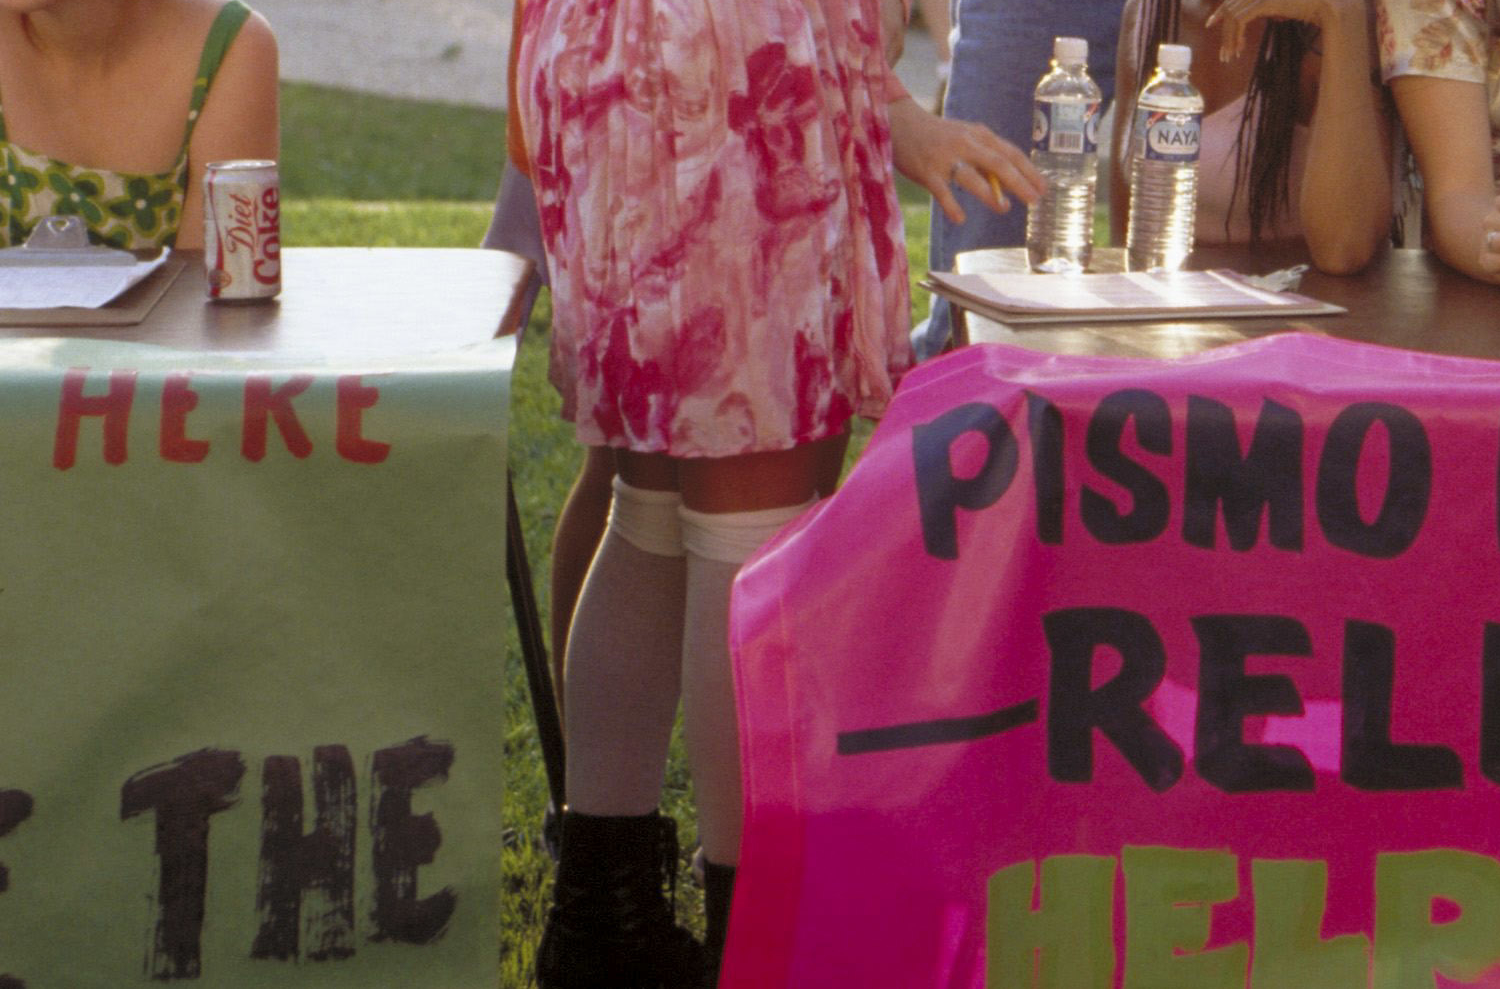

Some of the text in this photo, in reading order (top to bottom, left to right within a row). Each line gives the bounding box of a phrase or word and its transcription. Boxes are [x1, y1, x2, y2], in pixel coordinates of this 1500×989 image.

[1157, 130, 1199, 146] NAYA
[225, 192, 253, 257] Diet
[253, 186, 280, 285] Coke
[912, 389, 1432, 560] PISMO
[120, 734, 458, 981] THE
